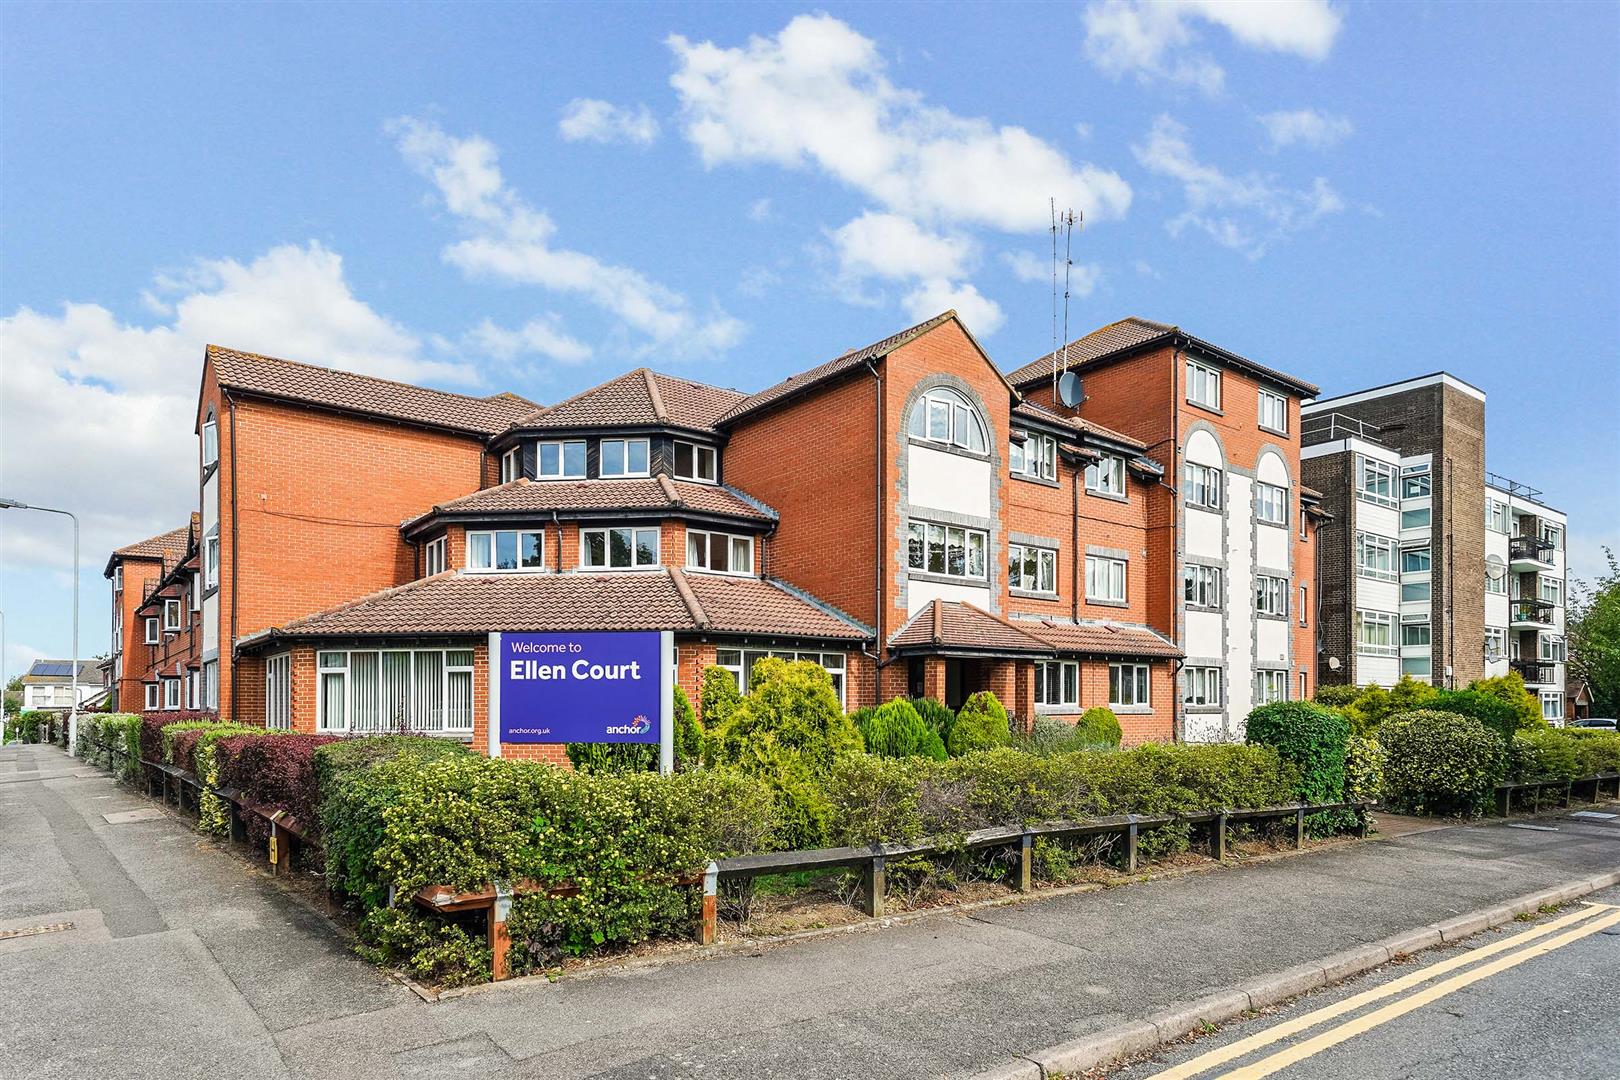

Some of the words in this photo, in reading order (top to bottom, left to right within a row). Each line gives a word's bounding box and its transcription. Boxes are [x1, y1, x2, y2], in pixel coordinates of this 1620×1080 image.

[511, 642, 566, 653] Welcome
[568, 642, 582, 653] to
[510, 660, 566, 680] Ellen
[571, 659, 641, 680] Court
[508, 727, 551, 736] anchor.org.uk
[606, 724, 641, 735] anchor
